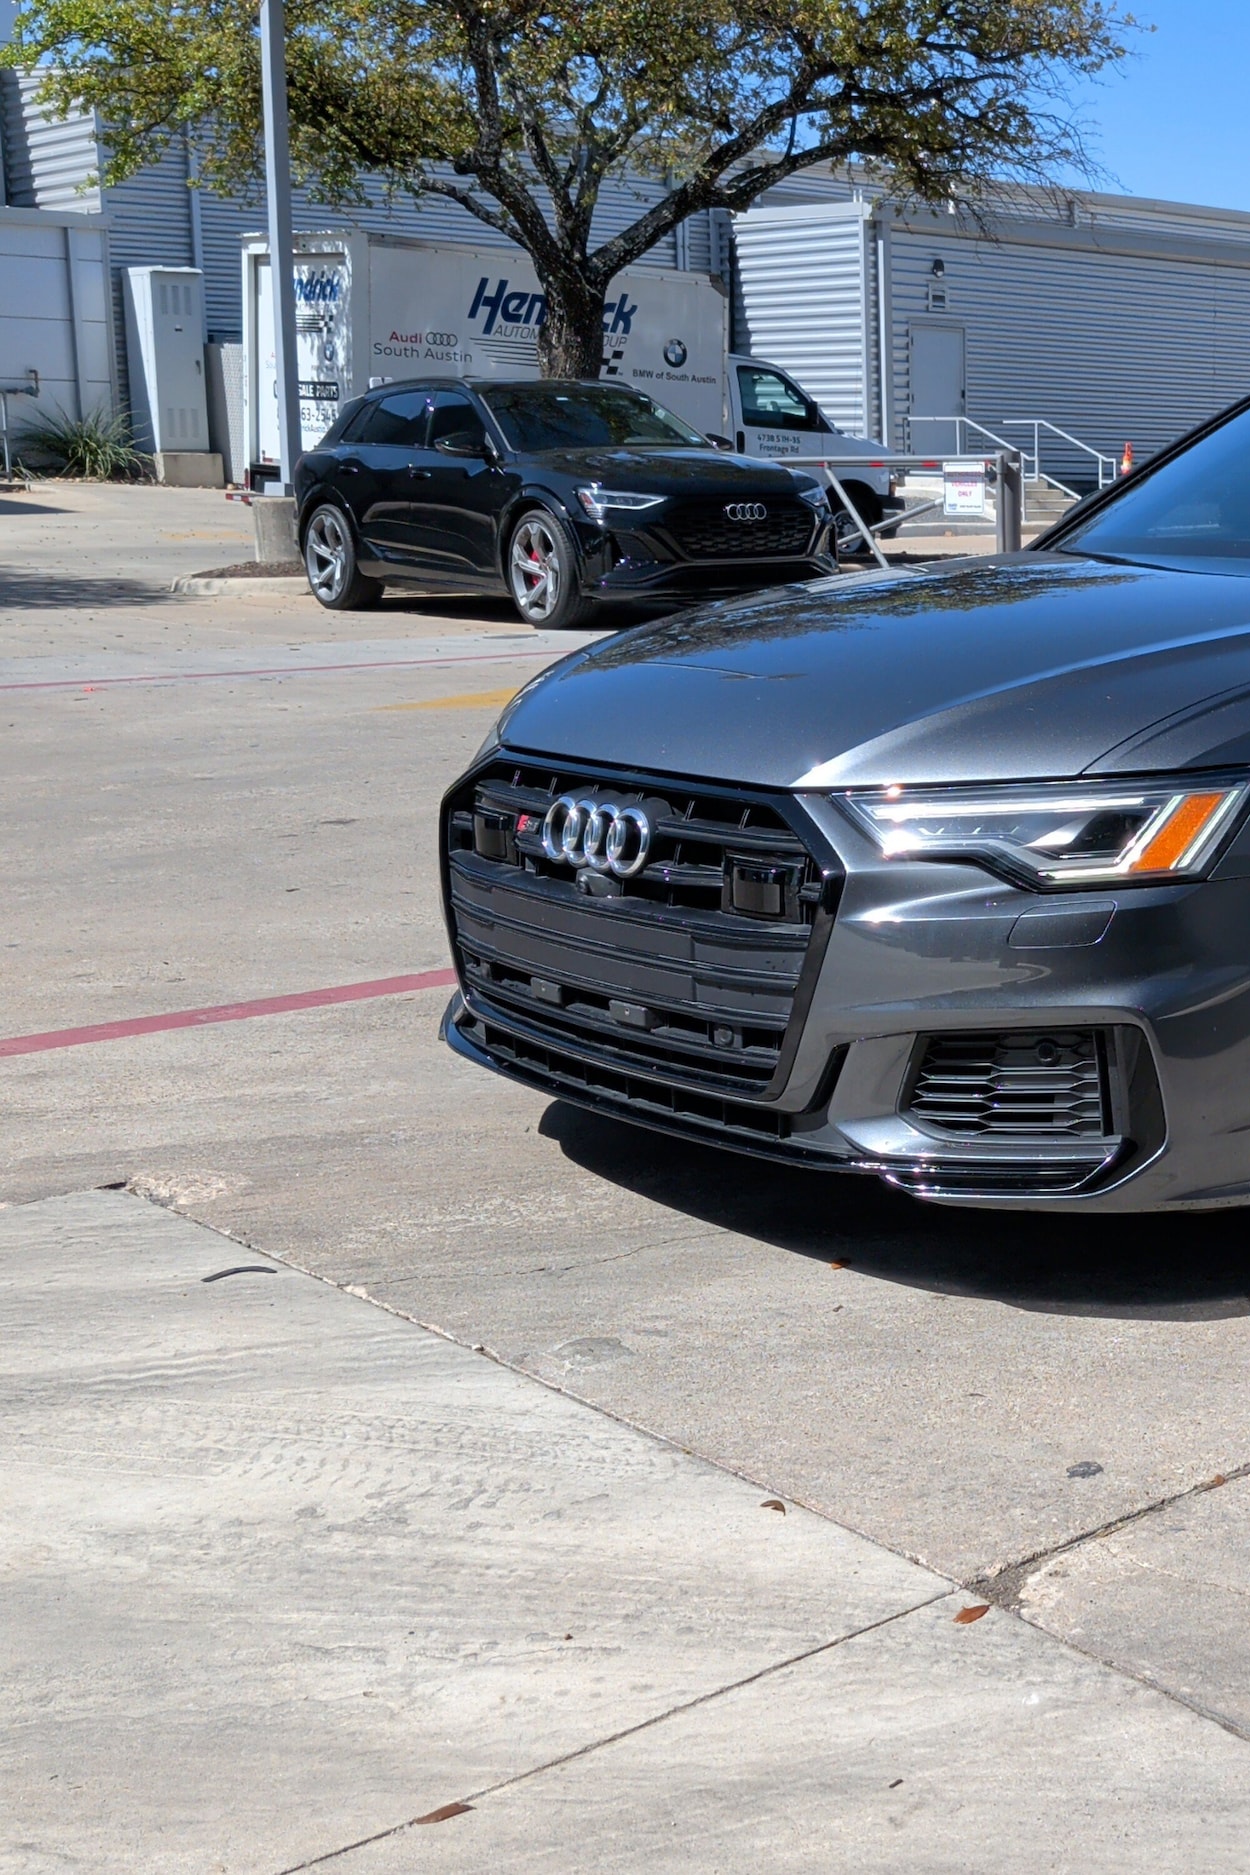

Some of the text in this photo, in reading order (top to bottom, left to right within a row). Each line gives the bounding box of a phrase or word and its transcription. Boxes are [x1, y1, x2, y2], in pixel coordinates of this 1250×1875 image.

[294, 270, 340, 302] ndrick
[467, 277, 638, 335] Henck
[389, 331, 422, 344] Audi
[493, 324, 628, 348] AUTOM OUP
[373, 343, 473, 363] South Austin
[632, 369, 653, 379] BMW
[655, 370, 664, 380] of
[666, 369, 689, 382] South
[691, 374, 717, 384] Austin
[298, 384, 314, 398] SALE
[759, 443, 799, 455] Frontage Rd
